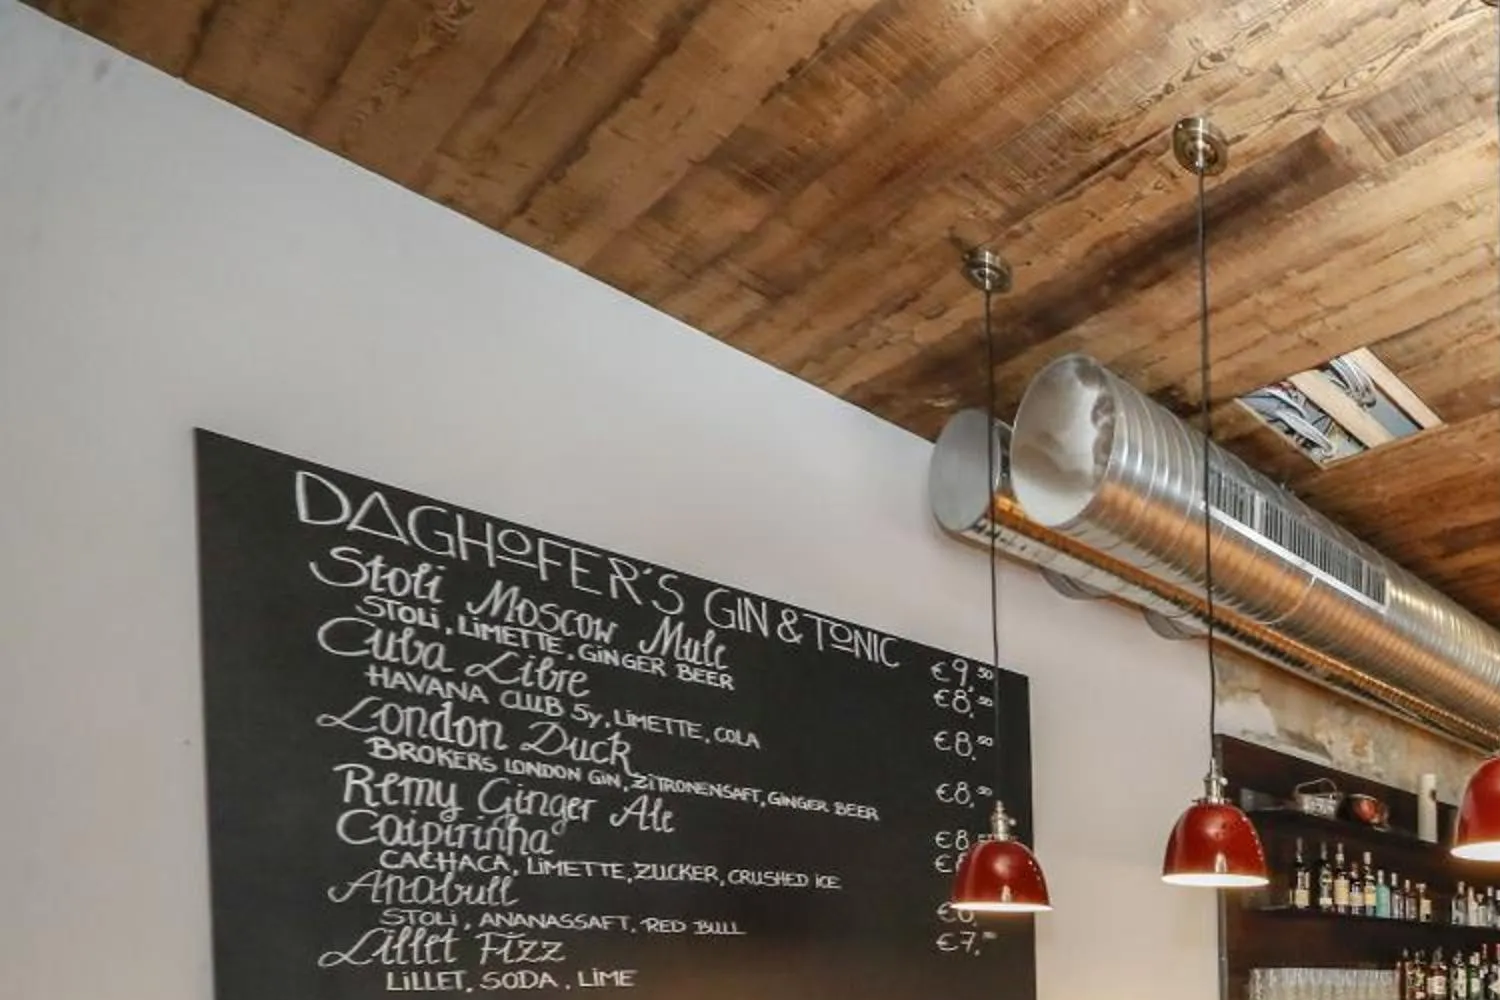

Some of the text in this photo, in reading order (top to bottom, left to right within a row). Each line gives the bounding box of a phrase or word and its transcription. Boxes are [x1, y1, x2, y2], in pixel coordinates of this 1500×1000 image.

[309, 546, 729, 672] Stoli Moscow Mule
[704, 588, 769, 638] GIN
[777, 608, 804, 645] &
[803, 612, 899, 668] TONIC
[317, 617, 591, 698] Cuba Libre
[676, 662, 735, 691] BEER
[316, 696, 508, 752] London
[364, 664, 490, 705] HAVANA
[500, 689, 564, 717] CLUB
[713, 726, 761, 750] COLA
[332, 763, 676, 834] Remy Ginger Ale
[364, 736, 499, 773] BROKERS
[504, 757, 582, 782] LONDON
[833, 801, 880, 821] BEER
[336, 809, 554, 858] Caipirinha
[727, 869, 809, 888] CRUSHED
[317, 926, 567, 967] Lillet Fizz
[639, 918, 686, 932] RED
[694, 920, 747, 935] BULL
